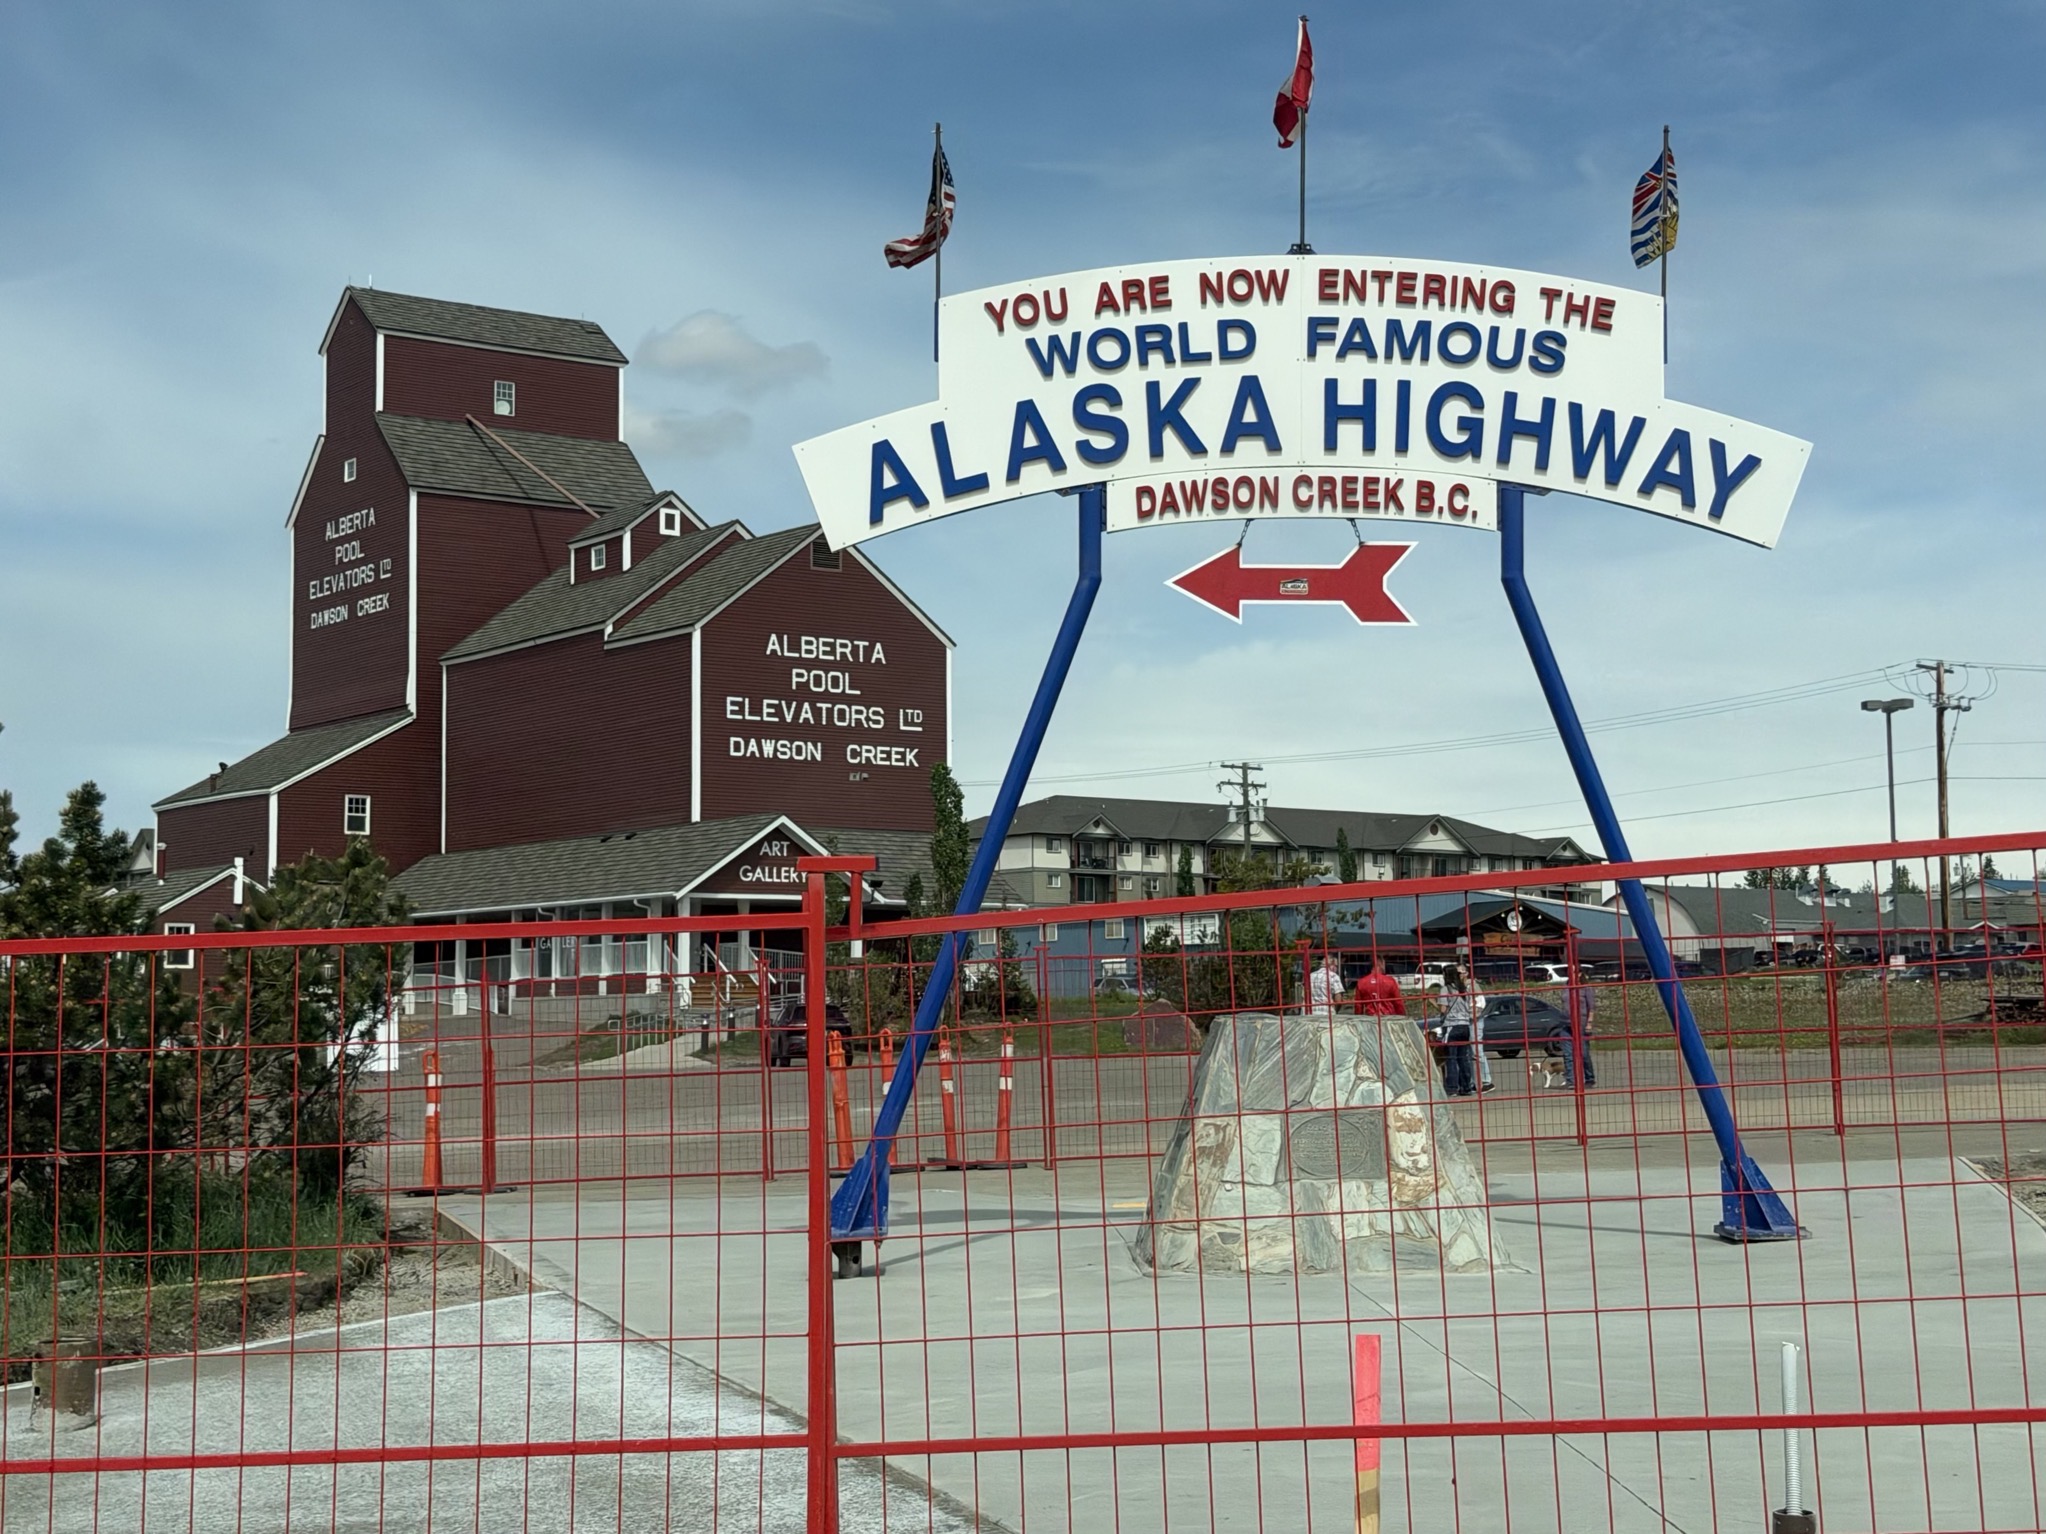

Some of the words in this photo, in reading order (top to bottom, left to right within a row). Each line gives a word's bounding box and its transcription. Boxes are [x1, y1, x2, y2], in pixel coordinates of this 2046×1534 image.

[984, 287, 1069, 333] YOU
[1095, 275, 1173, 315] ARE
[1199, 268, 1290, 304] NOW
[1318, 268, 1516, 315] ENTERING
[1540, 287, 1616, 332] THE
[1026, 318, 1257, 379] WORLD
[1307, 316, 1567, 373] FAMOUS
[869, 374, 1284, 526] ALASKA
[1323, 377, 1762, 521] HIGHWAY
[1135, 475, 1280, 519] DAWSON
[1292, 474, 1405, 511] CREEK
[1415, 480, 1478, 519] B.C.
[325, 507, 376, 541] ALBERTA
[335, 540, 365, 564] POOL
[309, 563, 375, 600] ELEVATORS
[380, 558, 391, 579] LTD
[310, 604, 348, 629] DAWSON
[356, 593, 390, 617] CREEK
[766, 633, 887, 665] ALBERTA
[791, 668, 862, 695] POOL
[726, 696, 885, 729] ELEVATORS
[899, 708, 923, 732] LTD
[729, 736, 822, 762] DAWSON
[846, 744, 919, 767] CREEK
[759, 840, 790, 857] ART
[739, 865, 808, 883] GALLERY
